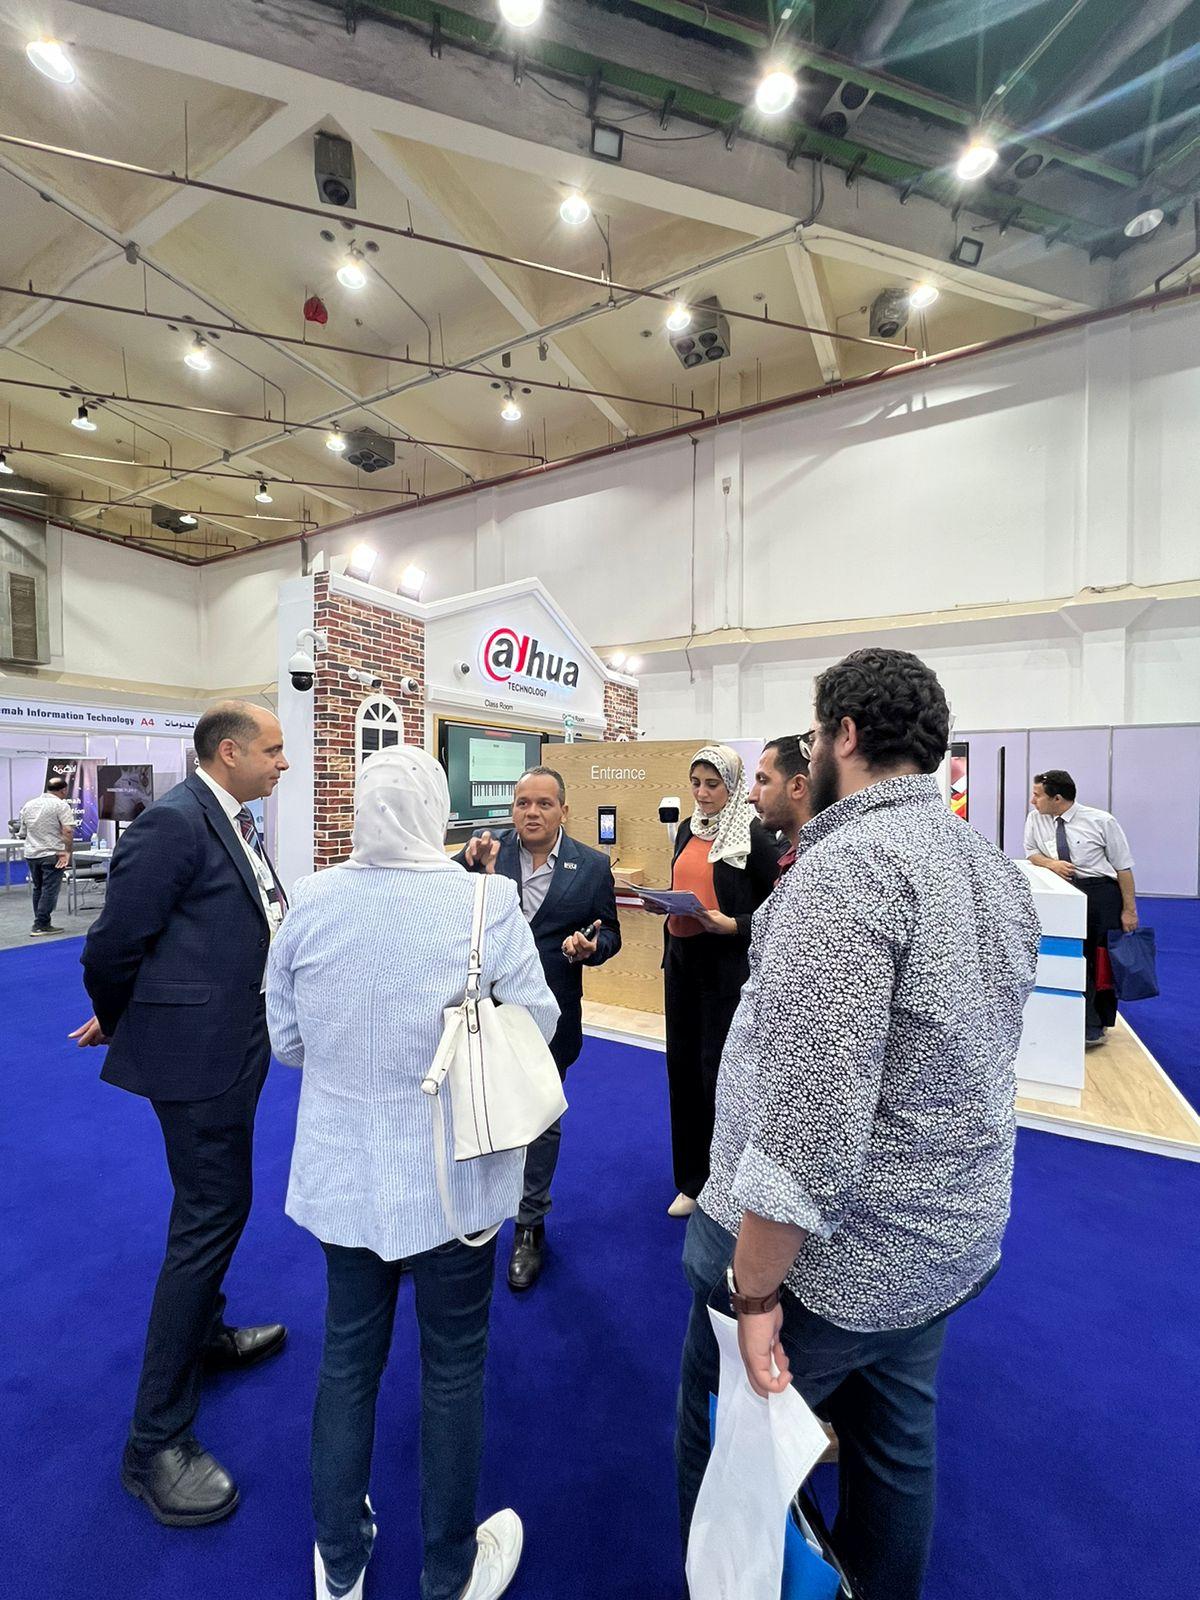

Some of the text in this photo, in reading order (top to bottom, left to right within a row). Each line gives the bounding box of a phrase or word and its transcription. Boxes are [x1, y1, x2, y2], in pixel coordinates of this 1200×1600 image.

[508, 682, 547, 697] TECHNOLOGY
[500, 701, 514, 711] Room
[0, 706, 155, 726] mah Information Technology A4
[591, 765, 646, 780] Entrance
